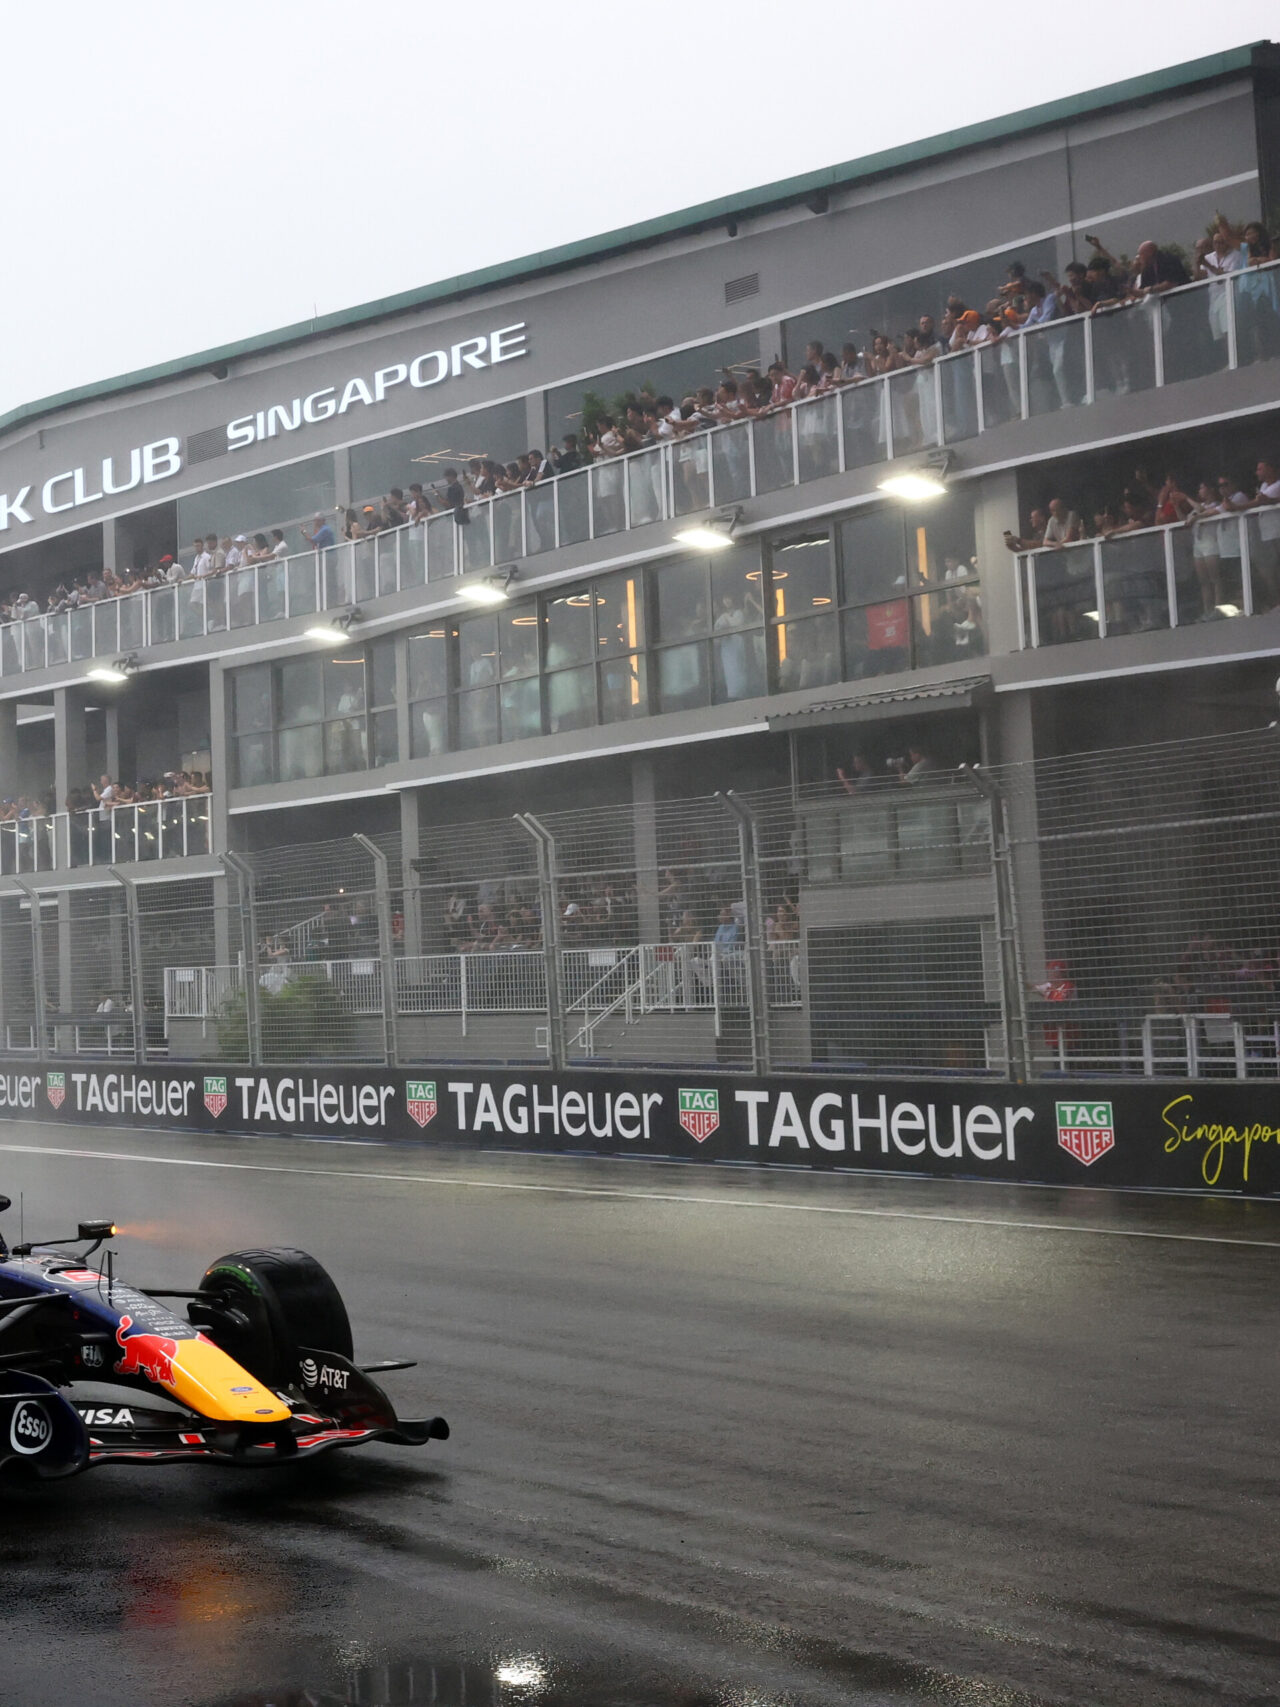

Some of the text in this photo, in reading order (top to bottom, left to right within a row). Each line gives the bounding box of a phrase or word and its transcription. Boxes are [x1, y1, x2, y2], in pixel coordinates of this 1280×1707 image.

[227, 321, 529, 451] SINGAPORE
[41, 436, 181, 514] CLUB
[48, 1073, 65, 1085] TAG
[205, 1078, 226, 1092] TAG
[409, 1083, 435, 1099] TAG
[682, 1091, 716, 1110] TAG
[408, 1100, 437, 1127] HEUER
[1060, 1105, 1108, 1126] TAG
[681, 1112, 718, 1141] HEUER
[1060, 1131, 1113, 1165] HEUER
[319, 1366, 350, 1390] AT&T
